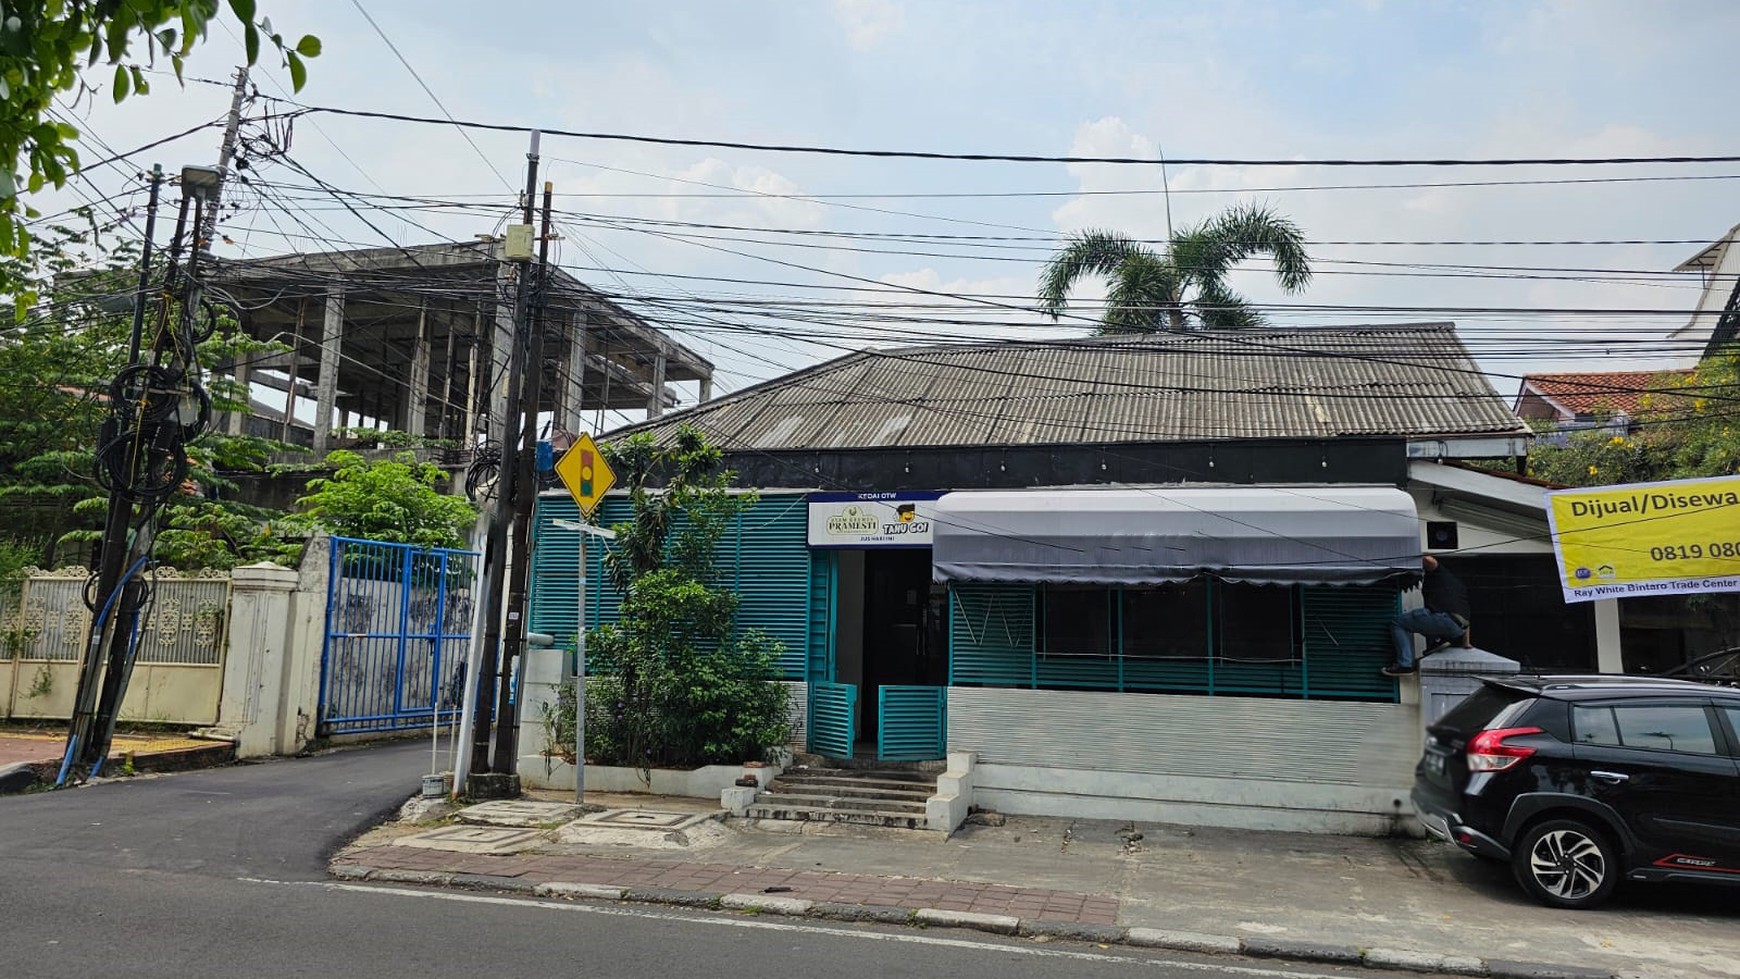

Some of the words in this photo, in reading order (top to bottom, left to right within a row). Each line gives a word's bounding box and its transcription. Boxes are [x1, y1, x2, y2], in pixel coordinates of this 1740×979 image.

[1571, 491, 1739, 518] Dijual/Disewa
[829, 522, 876, 531] PRAMESTI
[883, 523, 908, 535] TAHU
[909, 522, 928, 533] GOI
[1650, 544, 1703, 561] 0819
[1574, 588, 1593, 598] Ray
[1595, 586, 1625, 595] White
[1627, 582, 1667, 592] Bintaro
[1670, 580, 1700, 589] Trade
[1702, 578, 1737, 588] Center
